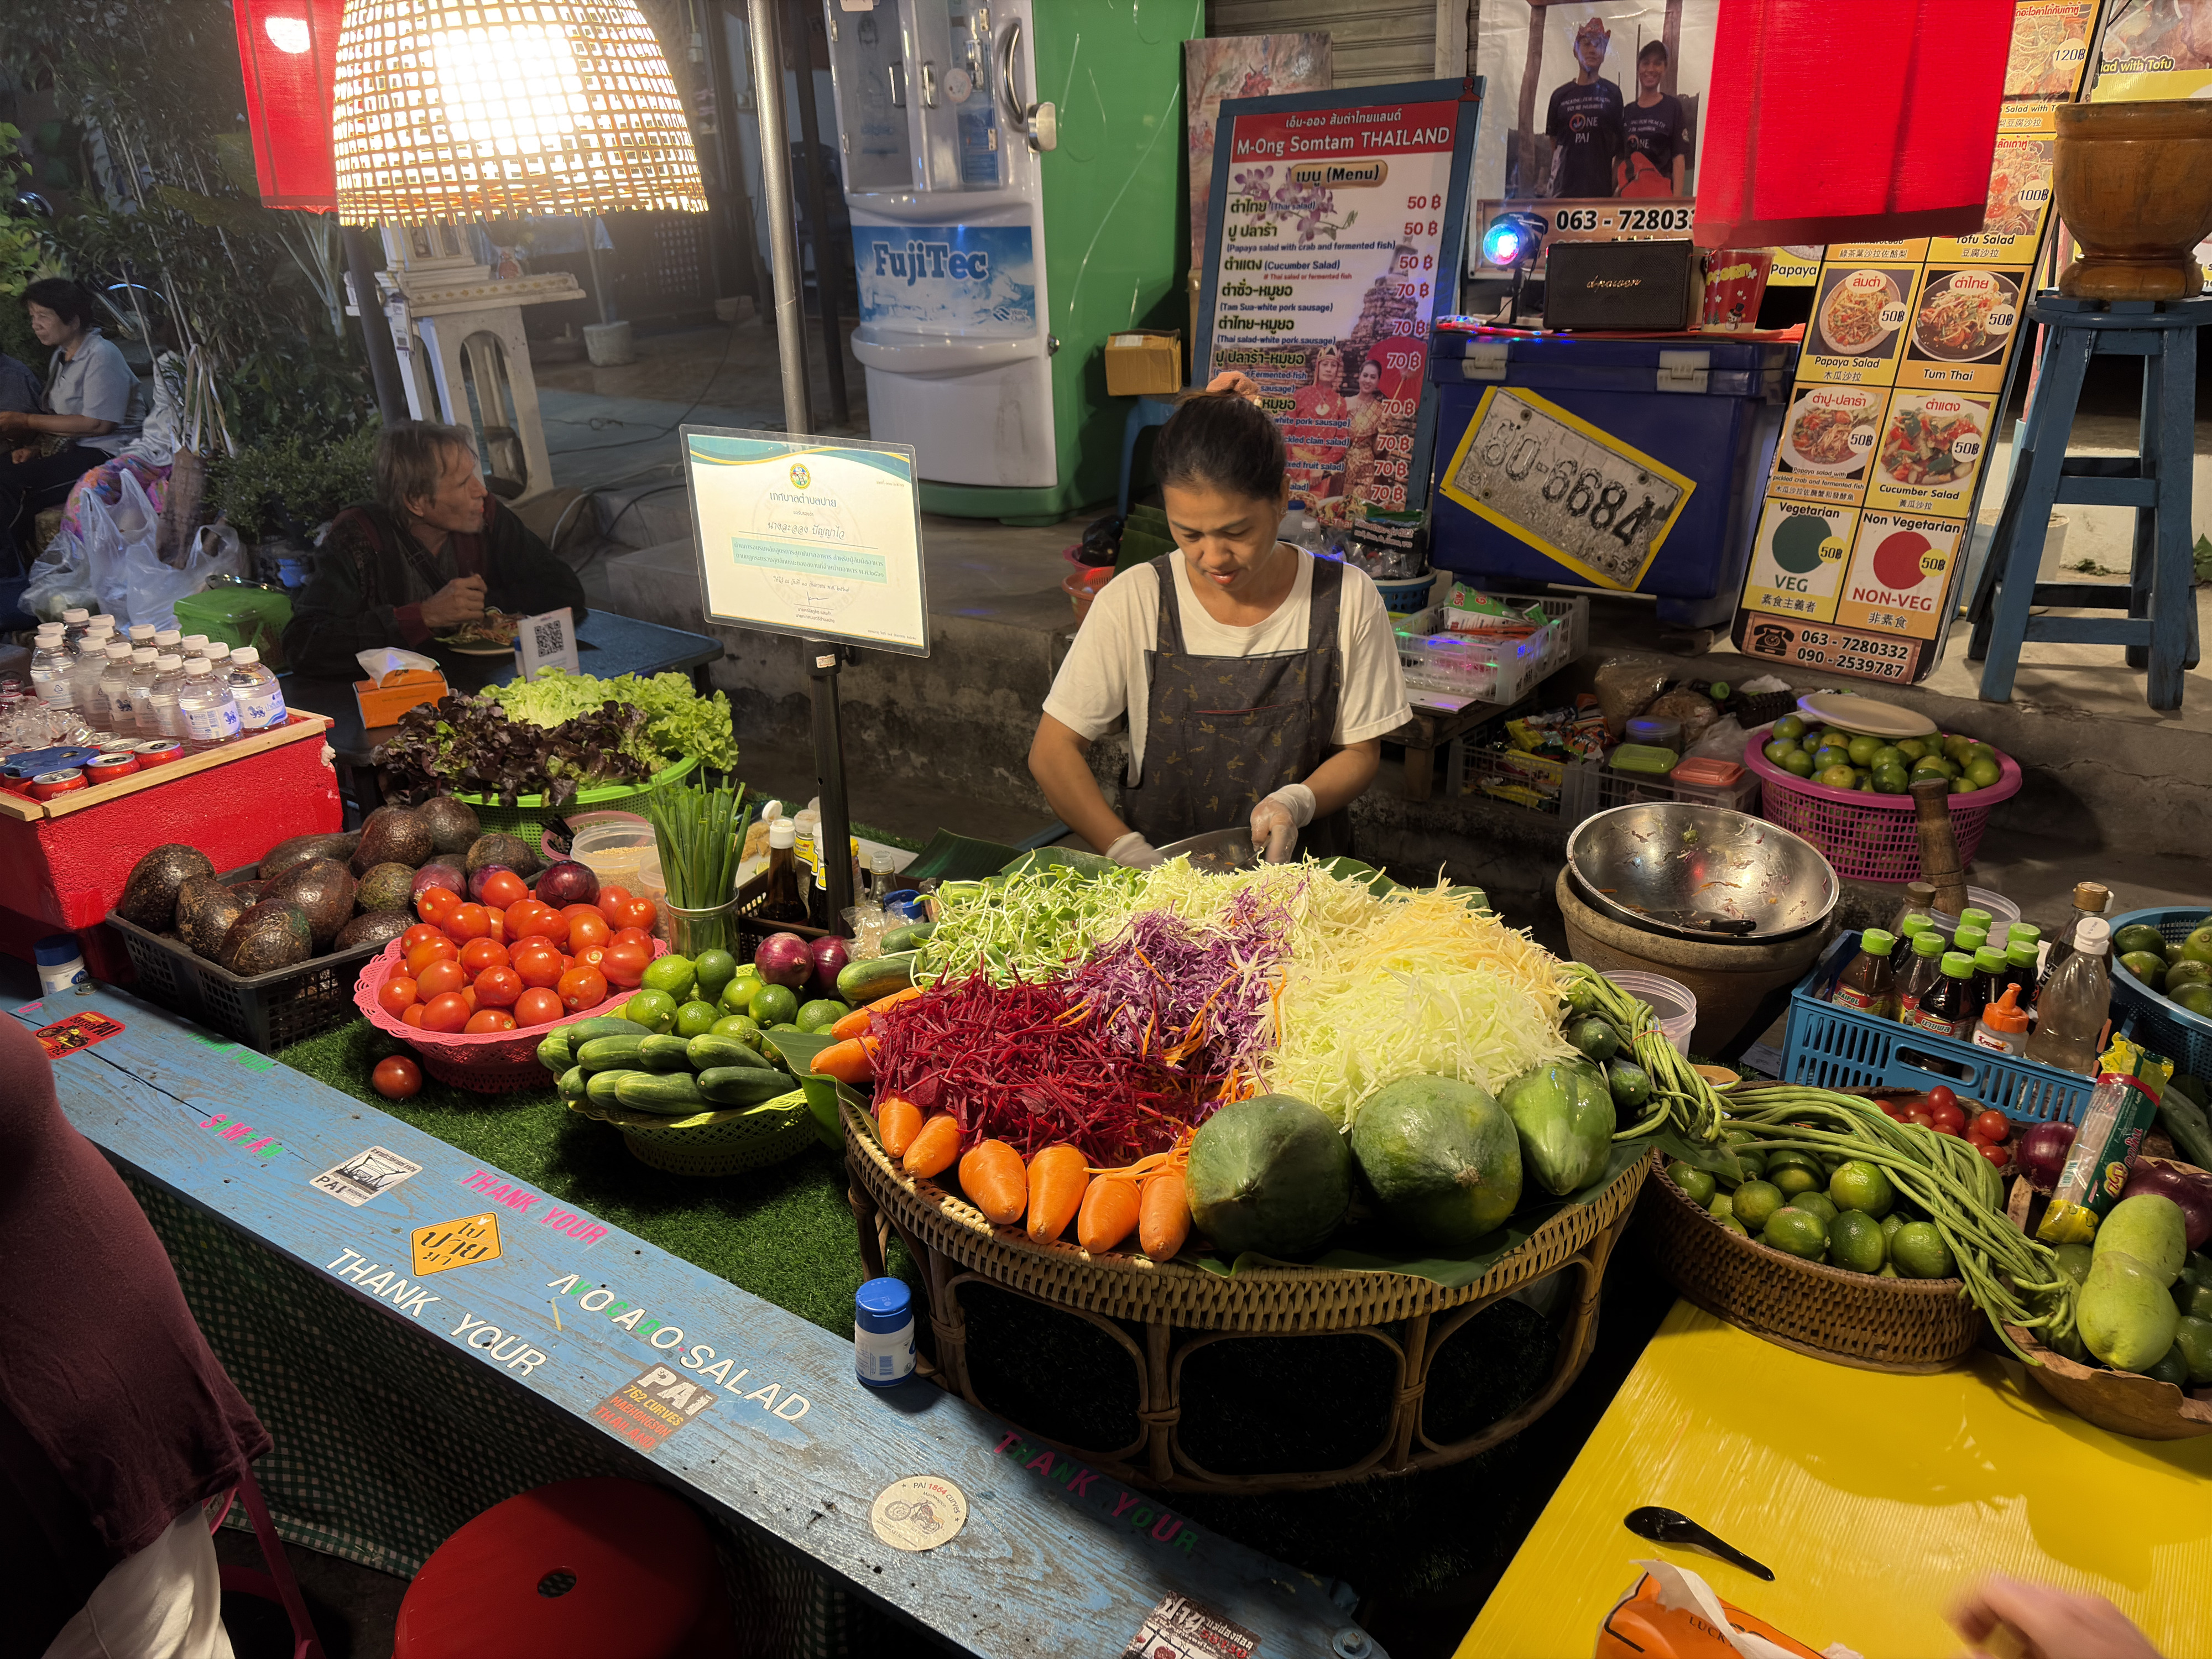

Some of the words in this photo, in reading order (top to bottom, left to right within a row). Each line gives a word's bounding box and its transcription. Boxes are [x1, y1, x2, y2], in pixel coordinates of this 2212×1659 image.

[2055, 48, 2086, 61] 120฿
[2121, 59, 2143, 71] with
[2147, 59, 2172, 71] Tofu
[1237, 138, 1285, 157] M-Ong
[1290, 135, 1354, 153] Somtam
[1361, 127, 1450, 148] THAILAND
[1296, 170, 1321, 187] เมนู
[1327, 165, 1380, 184] (Menu)
[2020, 188, 2049, 201] 100฿
[1407, 196, 1427, 210] 50
[1557, 210, 1597, 230] 063
[1404, 222, 1423, 236] 50
[1983, 234, 2015, 244] Salad
[1227, 244, 1257, 254] (Papaya
[1259, 243, 1279, 252] salad
[1318, 242, 1332, 251] and
[1376, 241, 1395, 250] fish)
[872, 240, 988, 287] FujiTec
[1264, 260, 1311, 271] (Cucumber
[1313, 259, 1340, 270] Salad)
[1400, 256, 1418, 269] 50
[1771, 264, 1817, 278] Papaya
[1853, 273, 1880, 288] ส้มตำ
[1954, 278, 1989, 290] ตำไทย
[1396, 284, 1415, 296] 70
[1279, 303, 1296, 312] pork
[1298, 303, 1333, 313] sausage)
[1882, 309, 1905, 323] 50฿
[1989, 312, 2013, 326] 50฿
[1392, 321, 1411, 334] 70
[1217, 335, 1236, 343] (Thai
[1281, 336, 1299, 345] pork
[1300, 336, 1336, 346] sausage)
[1387, 353, 1406, 368] 70
[1814, 356, 1849, 367] Papaya
[1852, 357, 1880, 369] Salad
[1823, 370, 1862, 382] 木瓜沙拉
[1923, 369, 1947, 380] Tum
[1950, 369, 1974, 381] Thai
[1383, 400, 1401, 414] 70
[1926, 399, 1960, 411] ตำแตง
[1314, 419, 1351, 428] sausage)
[1326, 437, 1349, 446] salad)
[1378, 436, 1397, 450] 70
[1850, 433, 1872, 447] 50฿
[1954, 441, 1979, 456] 50฿
[1302, 461, 1319, 469] fruit
[1321, 462, 1344, 472] salad)
[1375, 461, 1393, 475] 70
[1290, 483, 1310, 491] alad)
[1371, 486, 1390, 500] 70
[1879, 484, 1928, 497] Cucumber
[1931, 488, 1960, 500] Salad
[770, 492, 837, 507] เทศบาลตำบลปาย
[1779, 502, 1840, 519] Vegetarian
[1863, 513, 1888, 526] Non
[1893, 516, 1960, 534] Vegetarian
[1820, 547, 1843, 560] 50฿
[1921, 557, 1946, 572] 50฿
[1775, 574, 1808, 593] VEG
[1853, 587, 1932, 612] NON-VEG
[1868, 612, 1907, 629] 非素食
[1801, 630, 1828, 646] 063
[1842, 637, 1908, 660] 7280332
[1797, 648, 1824, 664] 090
[1837, 655, 1905, 678] 2539787
[1838, 990, 1860, 1005] NAIPOL
[92, 1022, 122, 1037] PAI
[1922, 1019, 1952, 1033] นายพล
[231, 1050, 274, 1073] YOUR
[315, 1176, 347, 1193] PAI
[461, 1170, 542, 1213] THANK
[540, 1207, 608, 1245] YOUR
[325, 1247, 442, 1318] THANK
[450, 1312, 547, 1377] YOUR
[680, 1344, 811, 1421] SALAD
[637, 1366, 713, 1416] PAI
[623, 1385, 648, 1402] 762
[643, 1399, 684, 1426] CURVES
[609, 1396, 672, 1438] MAEHONGSON
[595, 1406, 656, 1448] THAILAND
[928, 1483, 947, 1495] 1864
[946, 1494, 960, 1514] curves
[994, 1431, 1100, 1498] THANK
[1111, 1492, 1198, 1552] YOUR
[1689, 1616, 1733, 1647] LUCK
